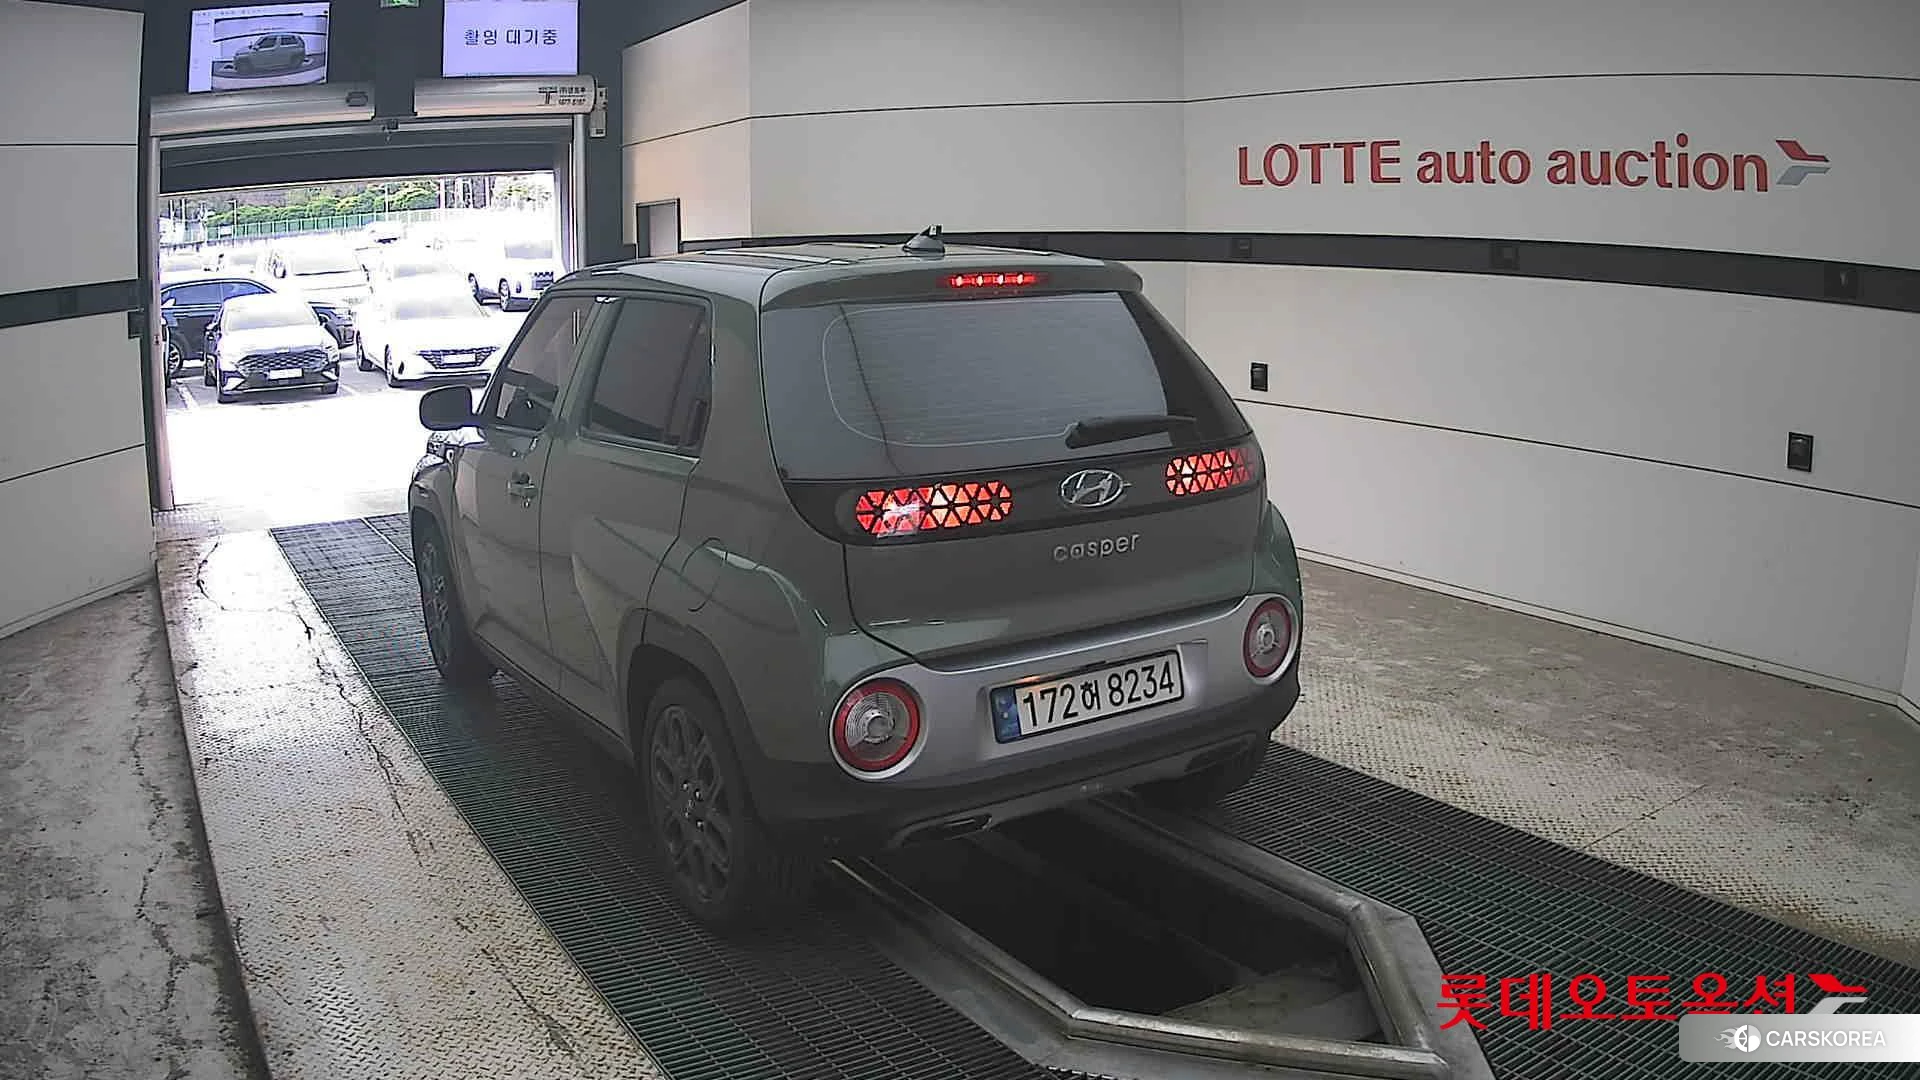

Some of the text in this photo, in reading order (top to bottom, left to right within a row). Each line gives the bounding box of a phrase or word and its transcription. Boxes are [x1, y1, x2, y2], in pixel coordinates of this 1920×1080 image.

[507, 29, 558, 46] 대기중
[1238, 133, 1769, 192] LOTTE auto auction
[1053, 533, 1140, 561] casper
[1108, 661, 1175, 706] 8234
